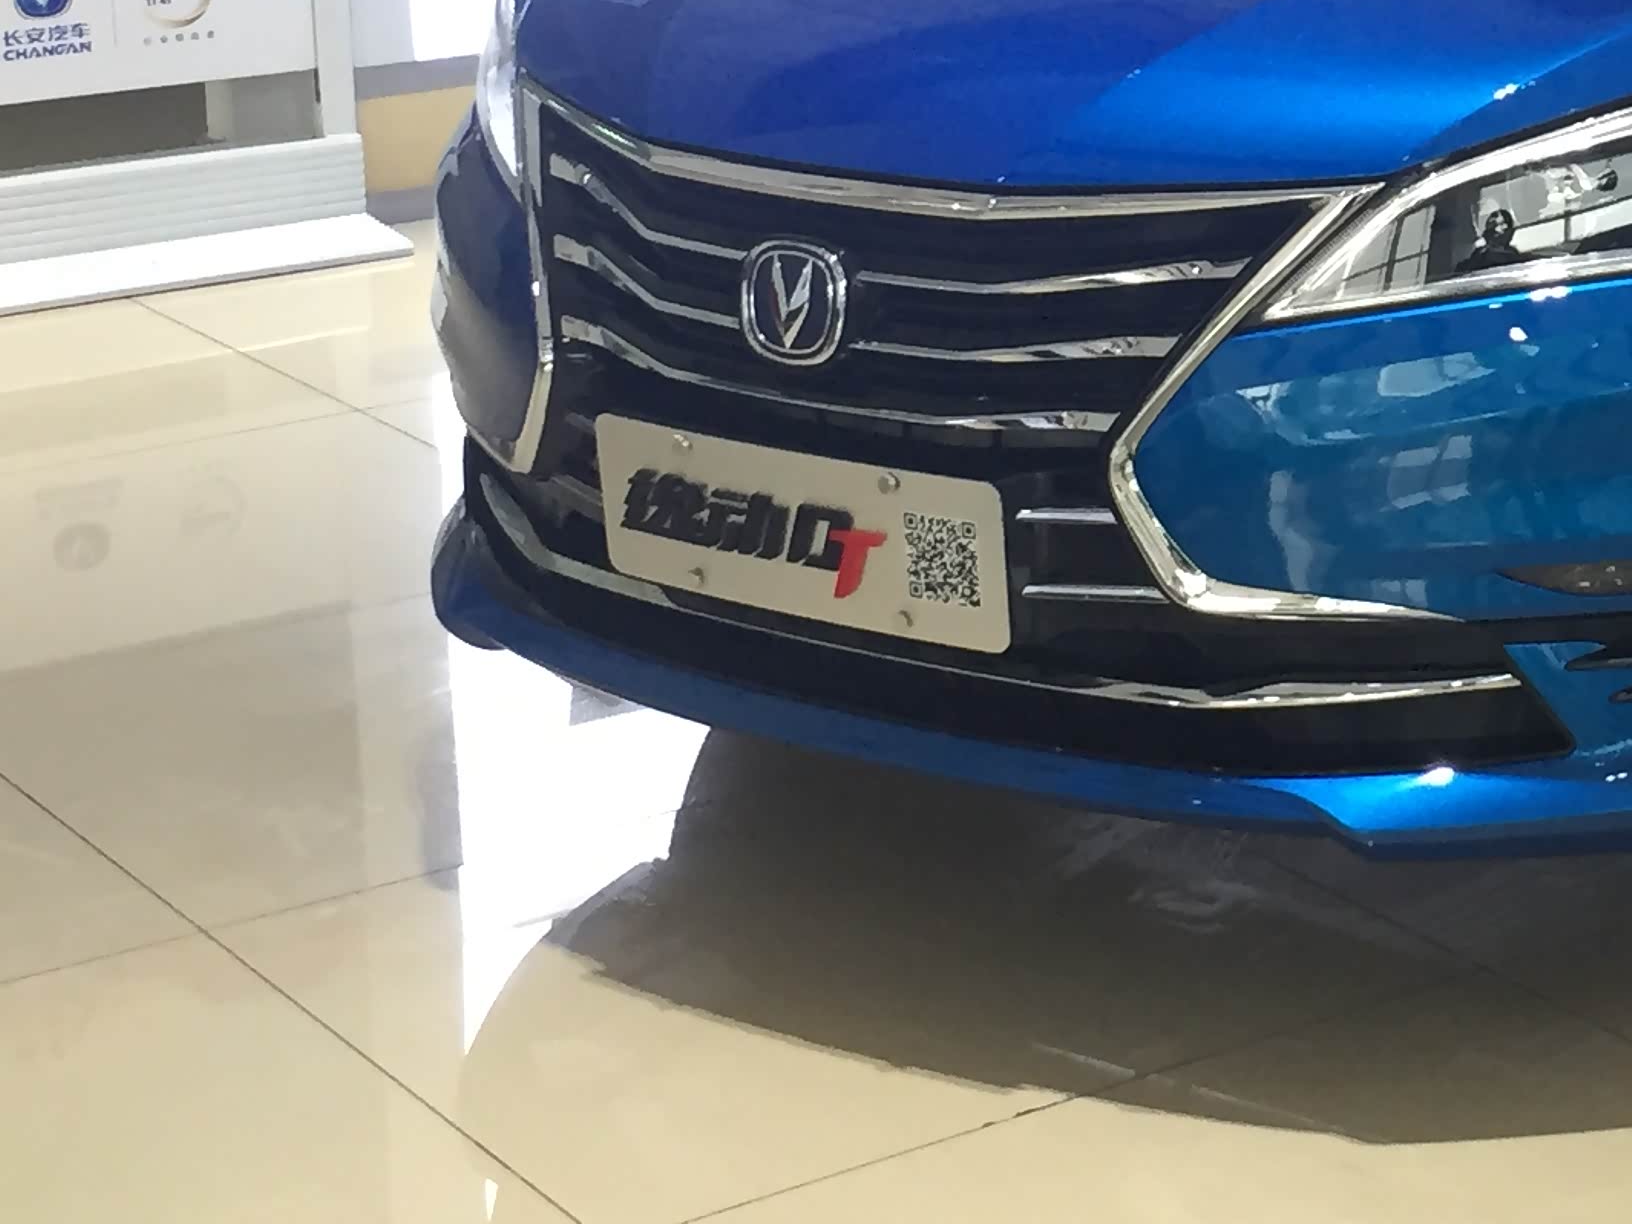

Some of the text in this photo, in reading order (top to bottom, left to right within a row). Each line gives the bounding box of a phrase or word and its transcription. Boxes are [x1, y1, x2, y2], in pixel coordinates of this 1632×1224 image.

[3, 22, 90, 47] 长安汽车
[3, 40, 92, 61] CHANGAN
